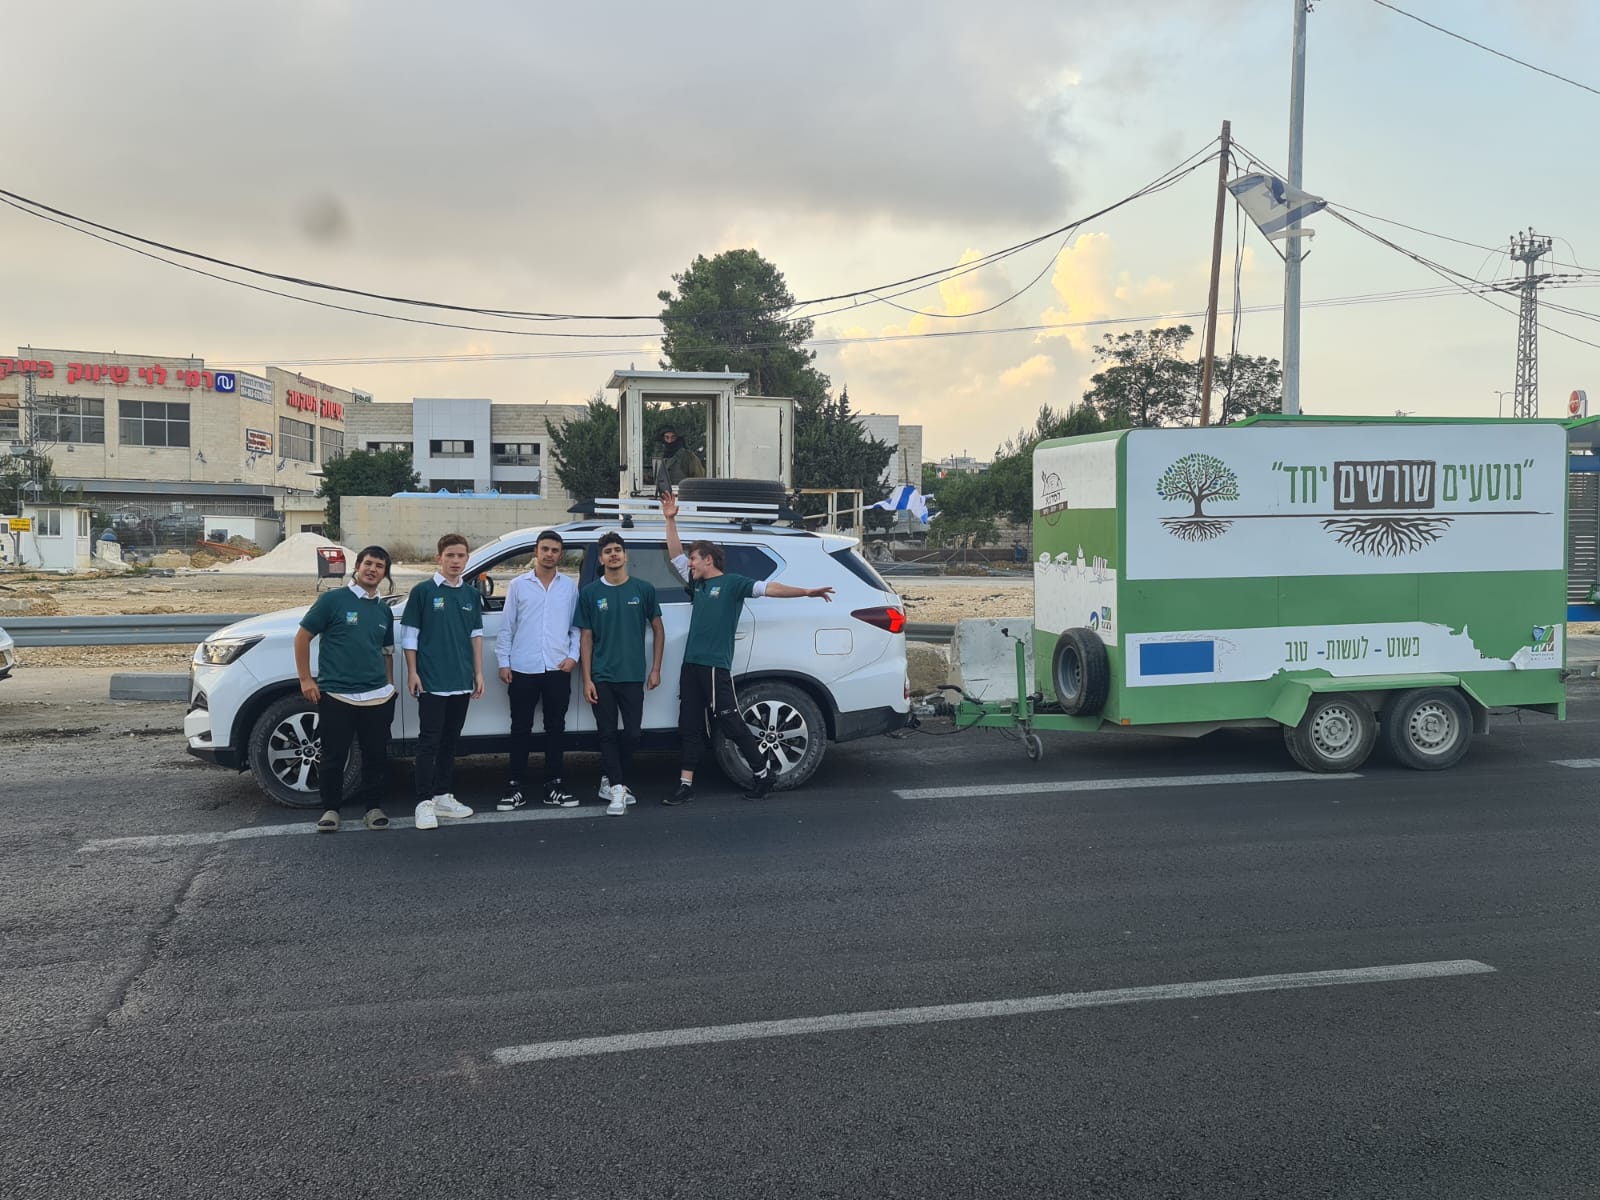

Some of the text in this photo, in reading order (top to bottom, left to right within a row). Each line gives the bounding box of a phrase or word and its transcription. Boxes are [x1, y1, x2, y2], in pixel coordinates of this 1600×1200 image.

[66, 362, 130, 384] שיווק
[138, 363, 167, 385] לוי
[176, 369, 213, 389] רמי
[287, 389, 318, 413] השקמה
[1338, 464, 1431, 503] שורשים
[1284, 641, 1308, 662] טוב
[1386, 636, 1420, 658] פשוט
